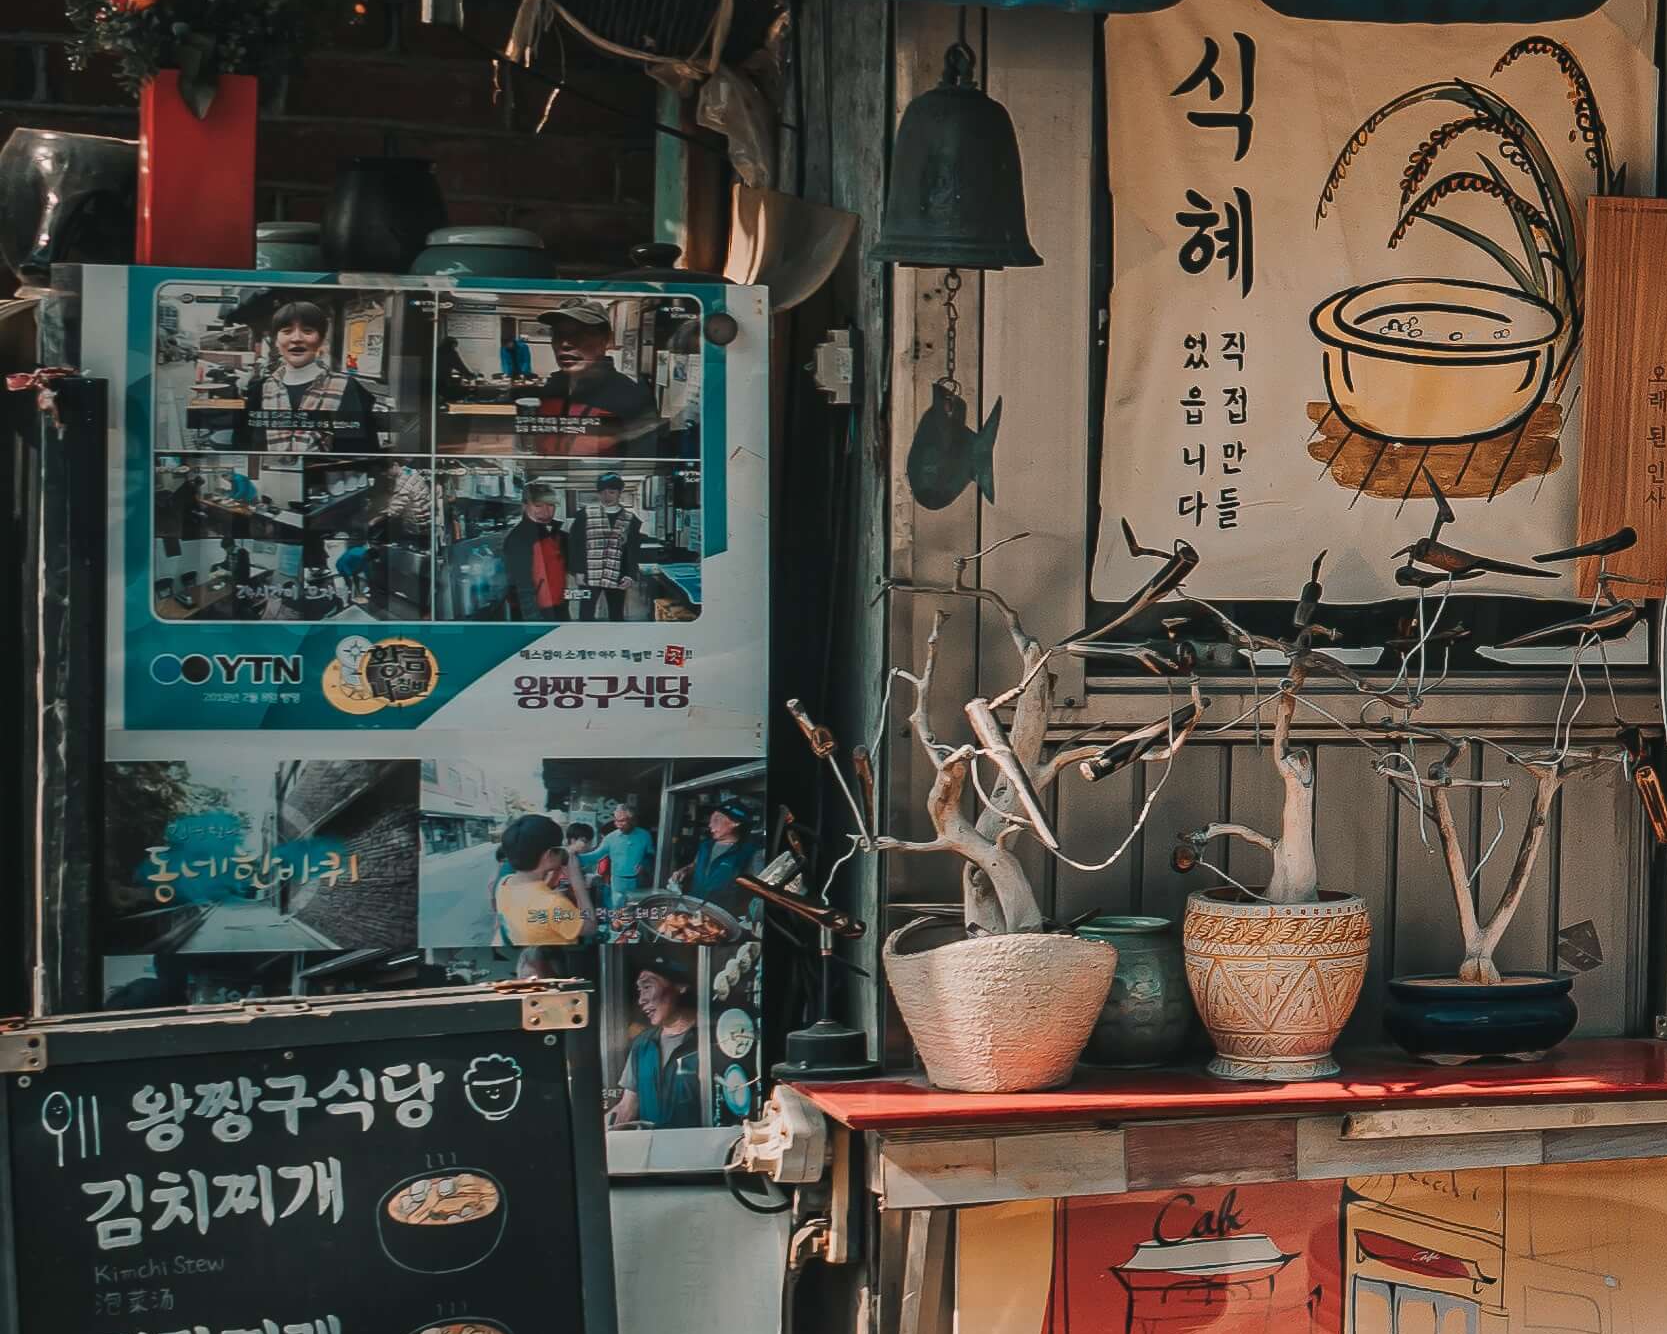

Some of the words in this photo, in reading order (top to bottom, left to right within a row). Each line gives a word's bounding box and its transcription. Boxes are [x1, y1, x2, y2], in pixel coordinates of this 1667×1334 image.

[1169, 32, 1257, 299] 식혜
[214, 654, 302, 684] YTN
[513, 675, 693, 710] 왕짱구식당
[127, 1062, 445, 1152] 왕짱구식당
[81, 1156, 344, 1250] 김치찌개
[94, 1258, 168, 1284] Kimchi
[173, 1254, 226, 1274] Stew
